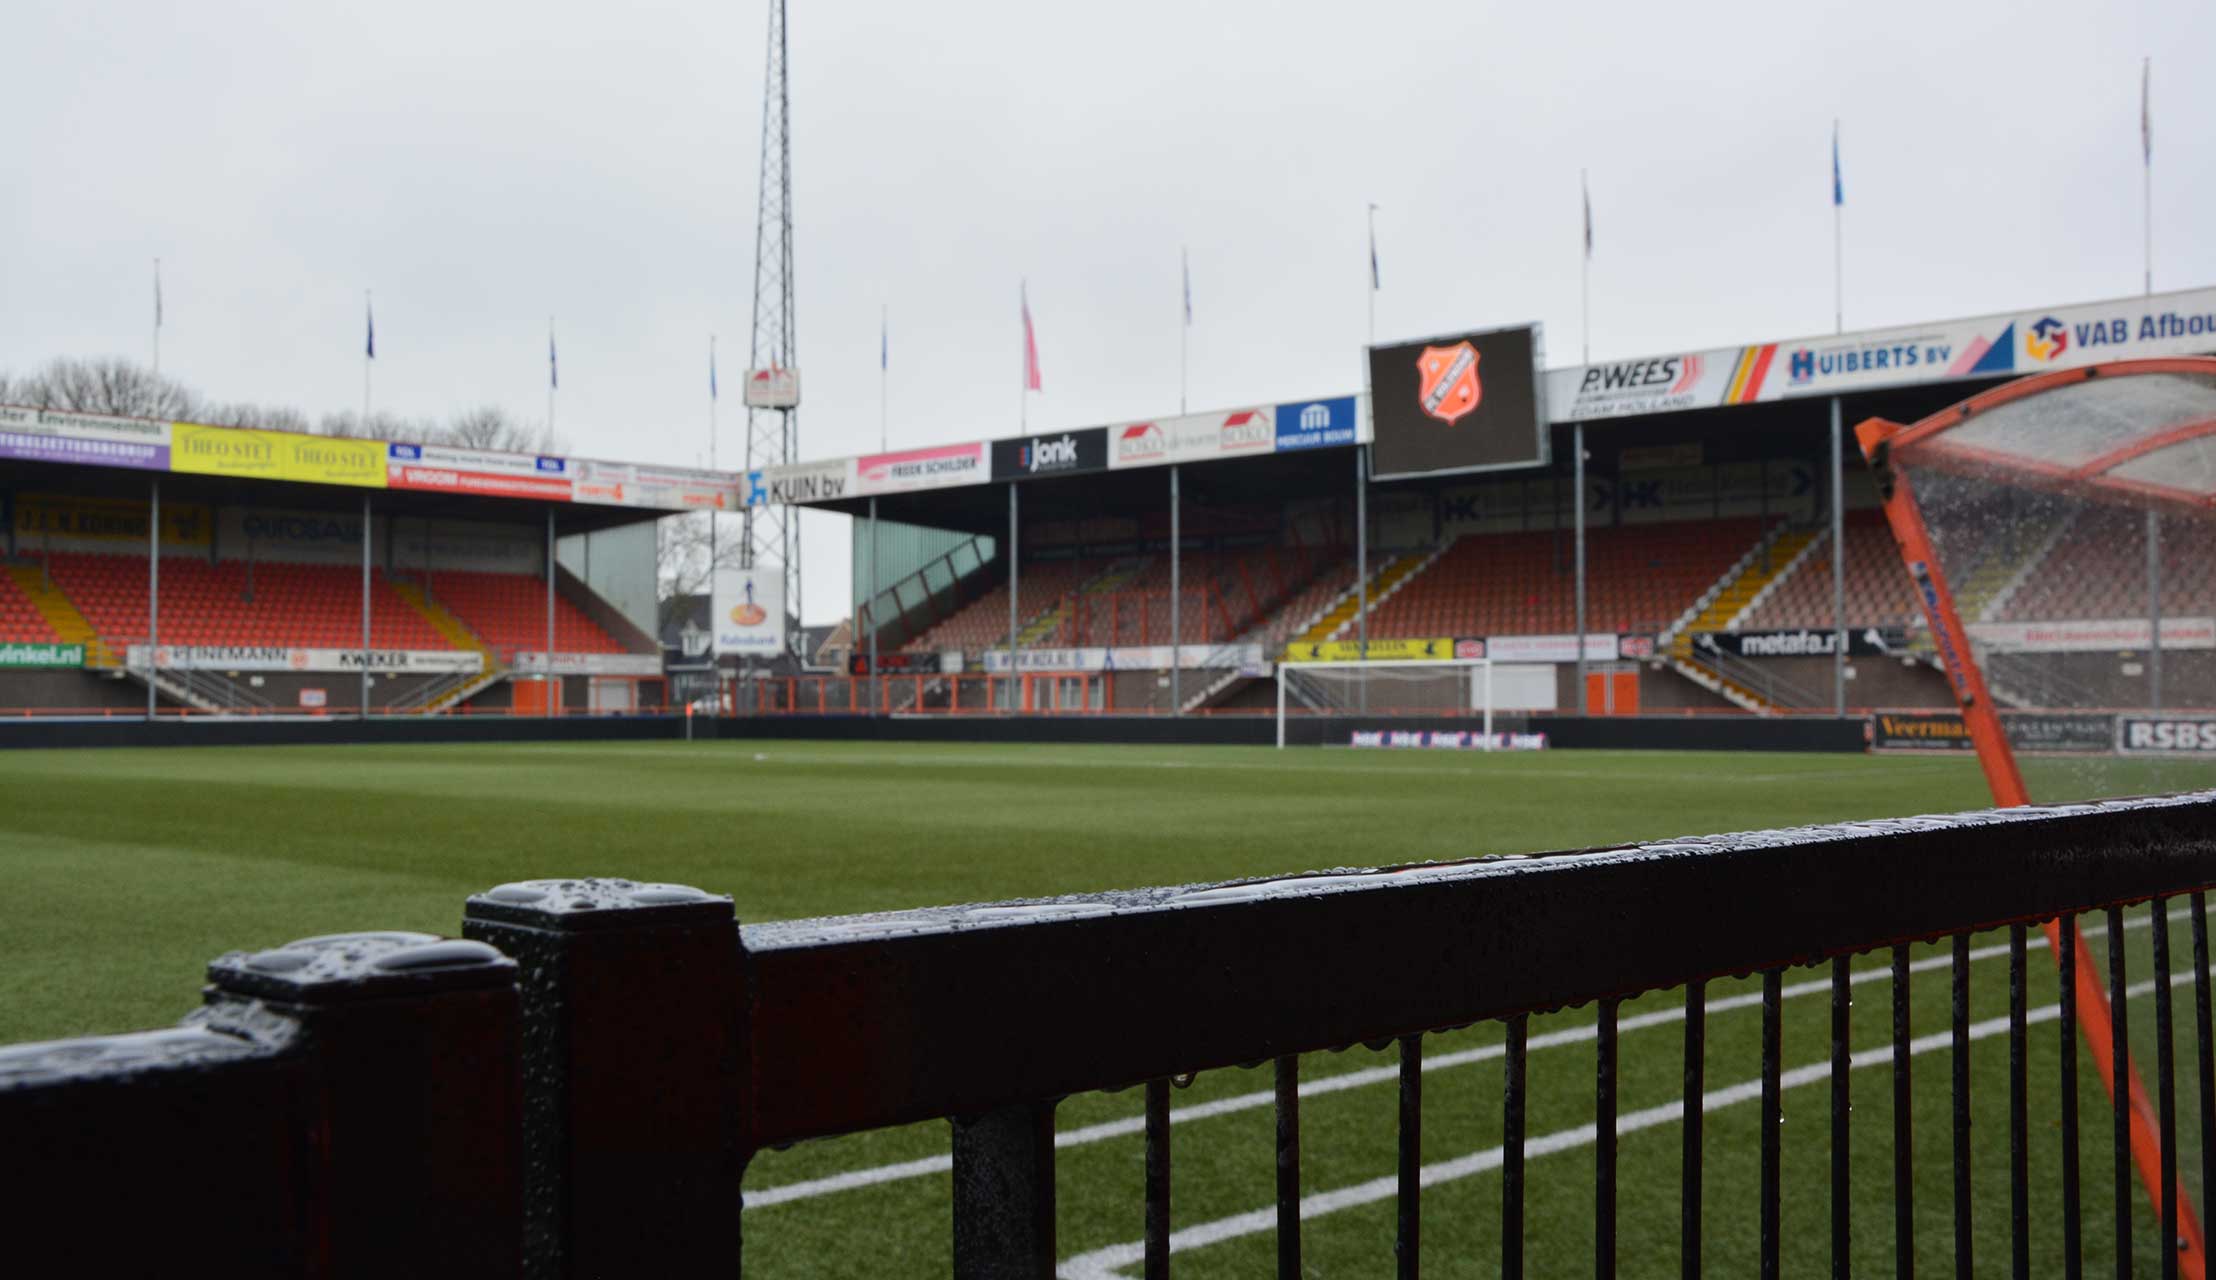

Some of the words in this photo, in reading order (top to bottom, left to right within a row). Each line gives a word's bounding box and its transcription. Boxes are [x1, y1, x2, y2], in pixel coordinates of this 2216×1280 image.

[2074, 317, 2128, 348] VAB
[2137, 310, 2216, 342] Afbou
[1789, 345, 1918, 379] HUIBERTS
[1924, 345, 1952, 364] BV
[181, 435, 230, 456] THEO
[1276, 431, 1322, 448] MERCUUR
[1323, 428, 1353, 444] BOUW
[293, 445, 337, 465] THEO
[1031, 435, 1077, 473] jonk
[890, 463, 922, 480] FREEK
[925, 457, 978, 476] SCHILDER
[771, 475, 816, 500] KUIN
[822, 473, 846, 498] bv
[720, 634, 777, 647] Rabobank
[339, 652, 408, 667] KWEKER
[1881, 715, 1971, 738] Veerma
[2129, 721, 2216, 749] RSBS
